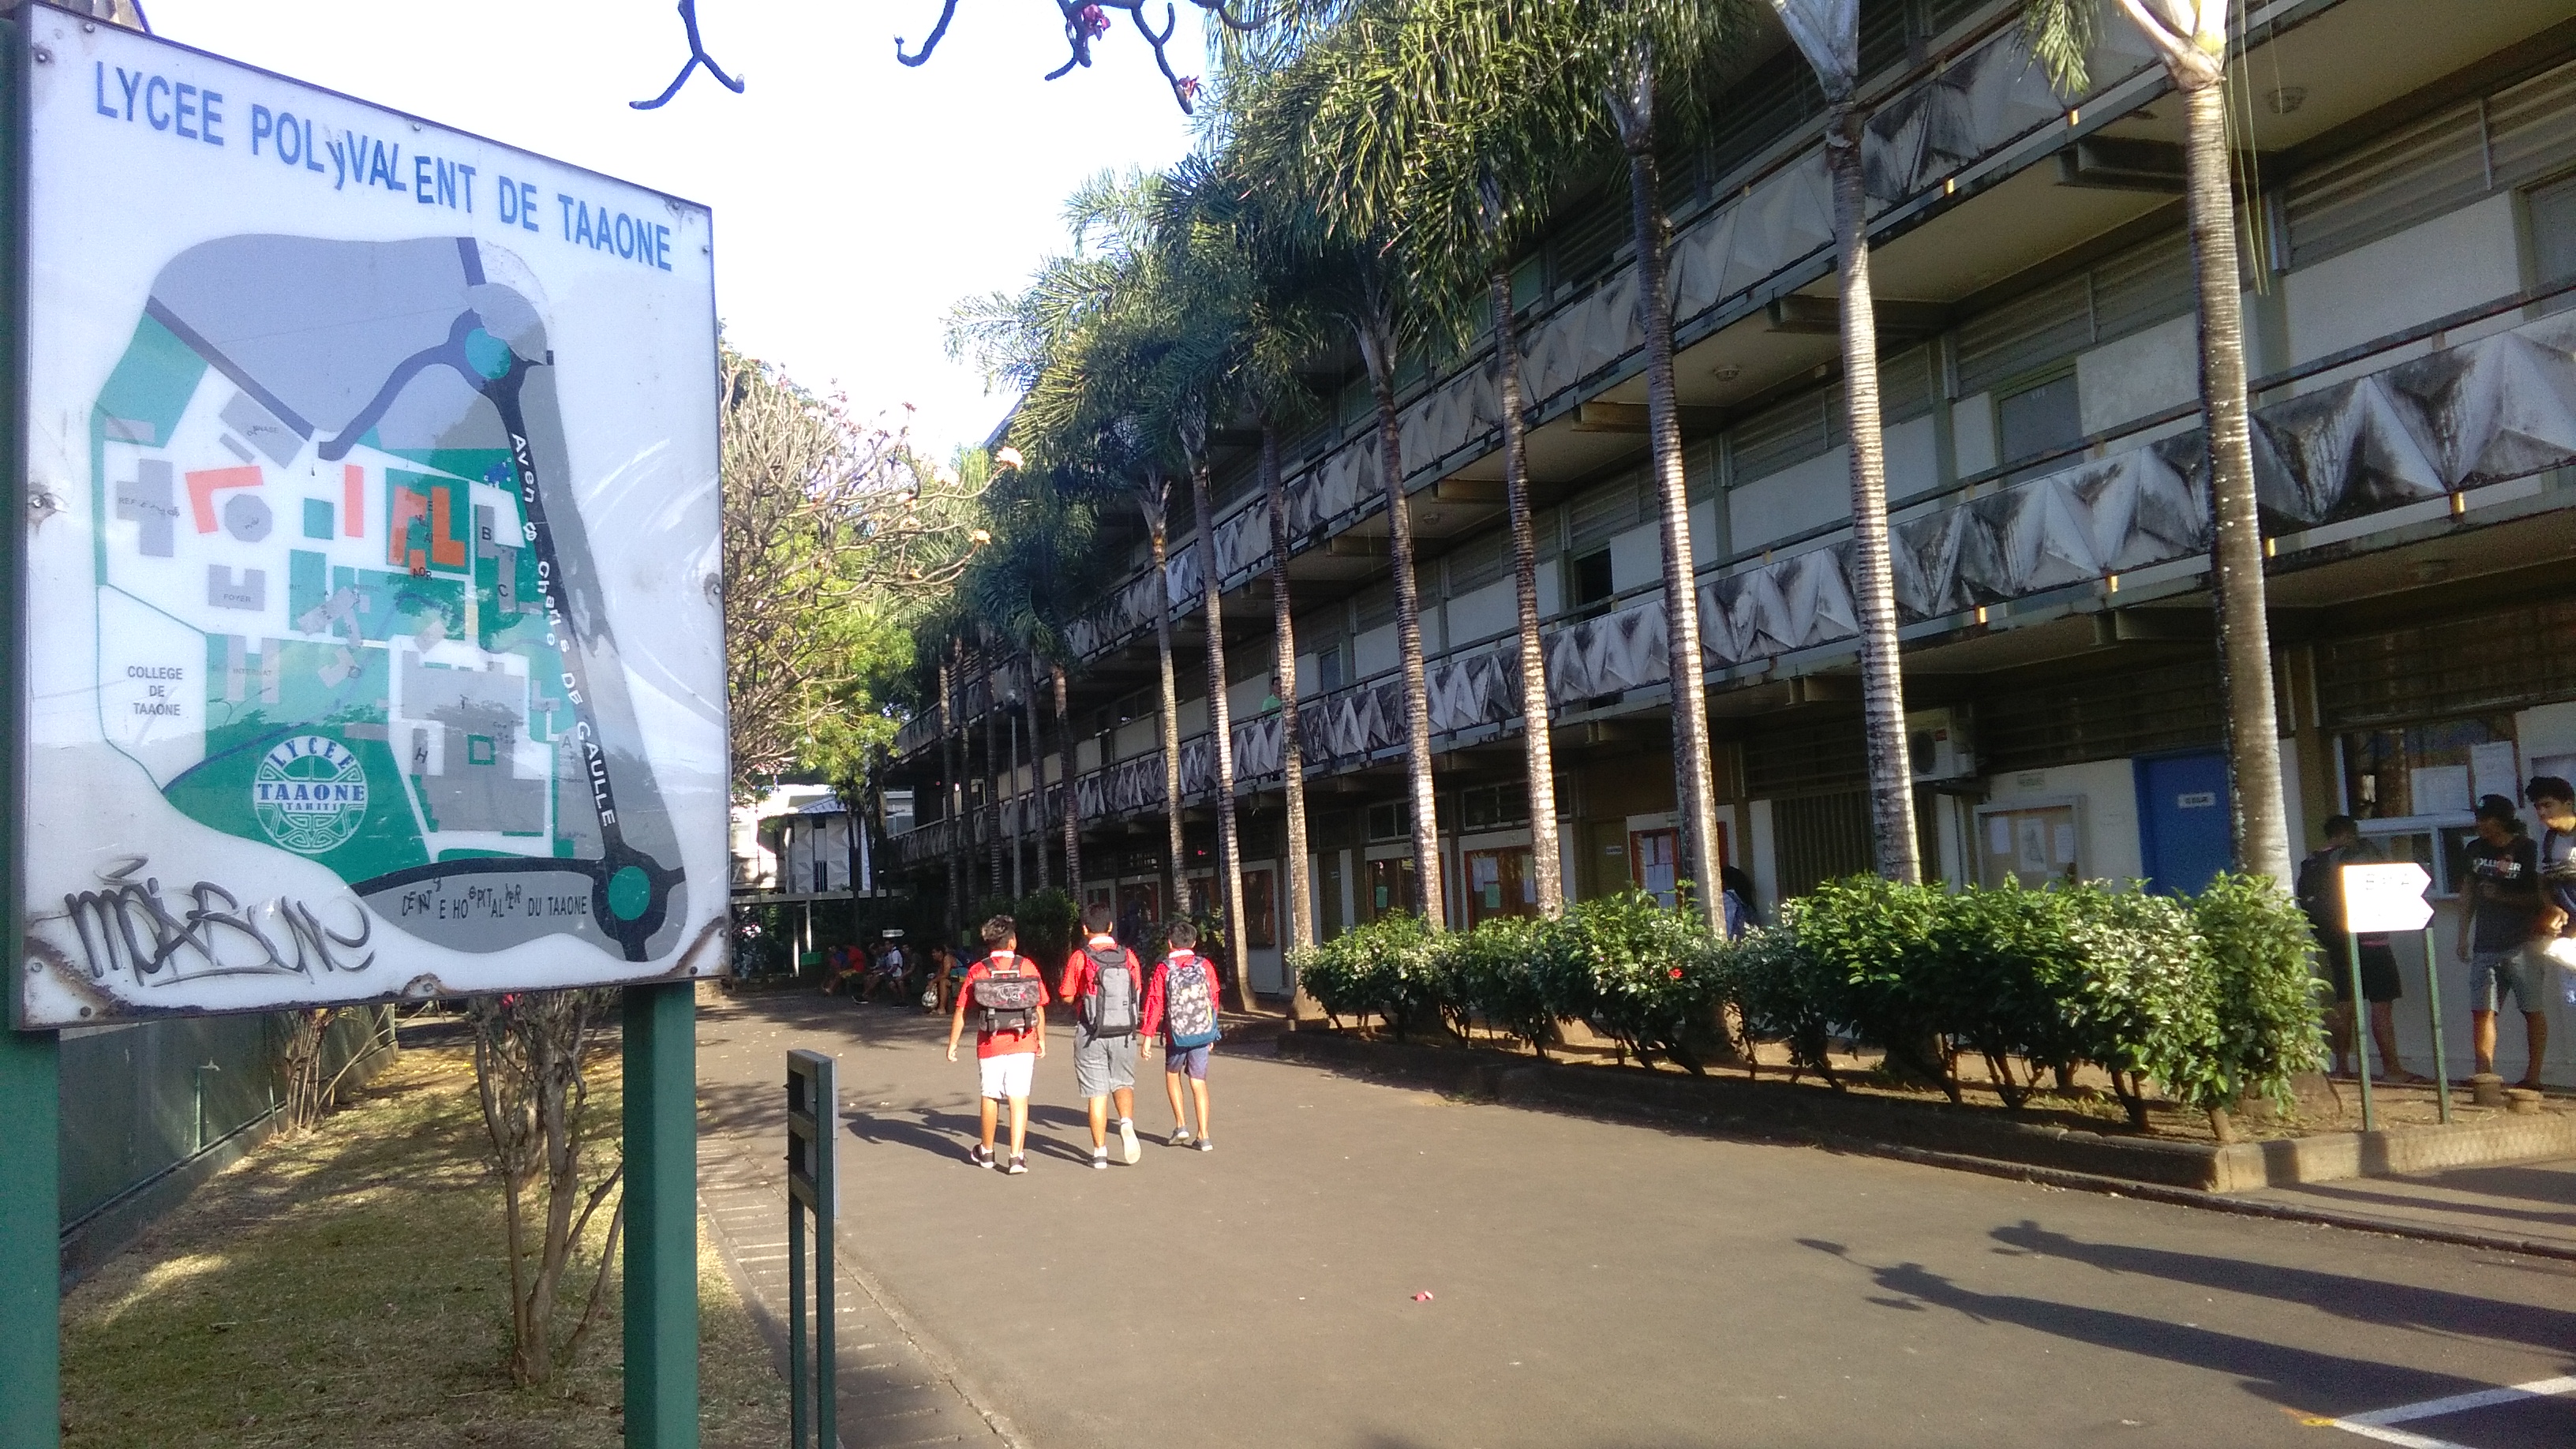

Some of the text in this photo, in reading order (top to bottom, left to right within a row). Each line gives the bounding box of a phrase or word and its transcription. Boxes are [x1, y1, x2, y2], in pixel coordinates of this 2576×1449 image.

[95, 61, 224, 146] LYCEE
[500, 175, 539, 232] DE
[557, 193, 672, 271] TAAONE
[481, 526, 492, 541] B
[498, 583, 508, 597] C
[127, 665, 183, 680] COLLEGE
[148, 684, 165, 698] DE
[133, 702, 181, 717] TAAONE
[561, 672, 583, 705] DE
[577, 721, 616, 827] GAULLE
[562, 735, 573, 749] A
[269, 736, 355, 770] LYCEE
[414, 747, 429, 764] H
[257, 783, 365, 802] TAAONE
[286, 802, 338, 811] TAHITI
[528, 897, 542, 917] DU
[548, 895, 587, 916] TAAONE
